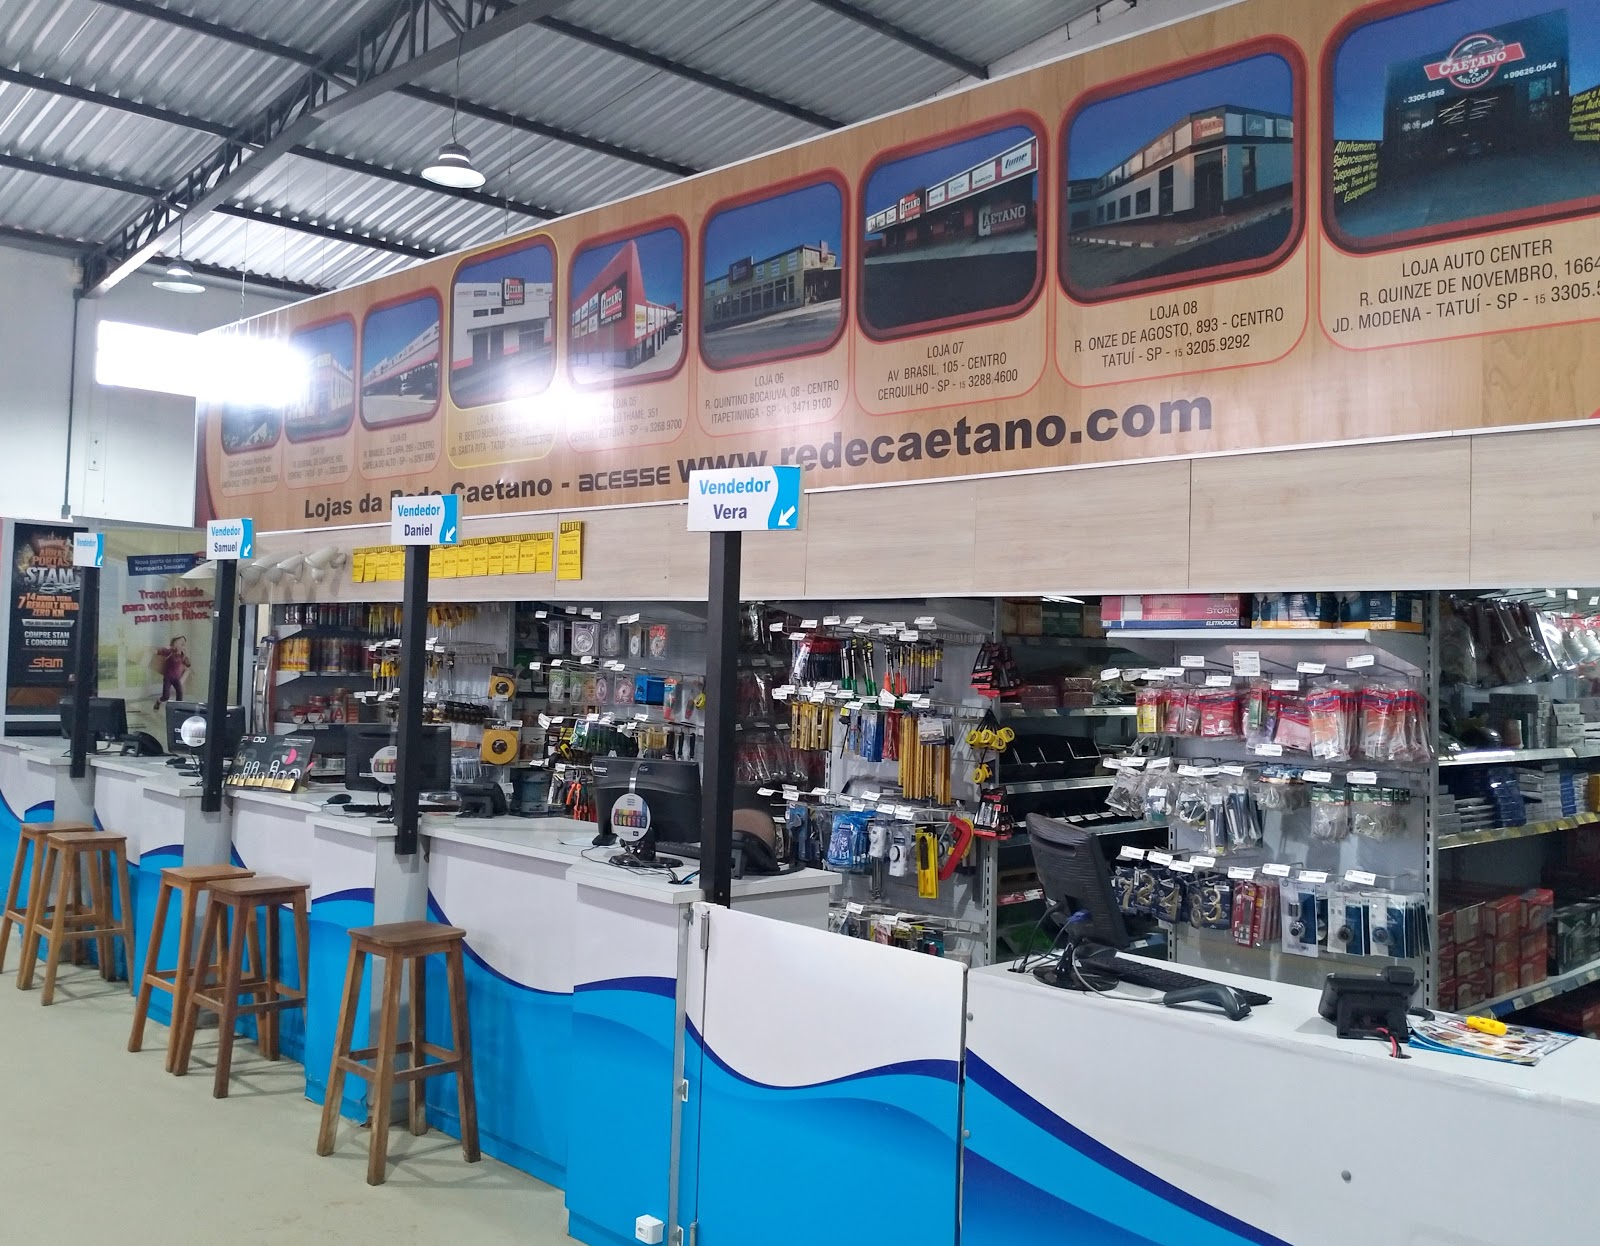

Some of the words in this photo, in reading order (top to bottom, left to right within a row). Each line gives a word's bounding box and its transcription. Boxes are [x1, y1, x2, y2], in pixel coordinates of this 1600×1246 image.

[1438, 51, 1507, 76] CAETANO
[978, 204, 1026, 237] CAETANO
[1402, 256, 1439, 278] LOJA
[1443, 249, 1485, 271] AUTO
[1490, 238, 1553, 263] CENTER
[1359, 291, 1373, 307] R.
[1378, 281, 1432, 304] QUINZE
[1437, 278, 1456, 296] DE
[1461, 262, 1558, 292] NOVEMBRO,
[1150, 303, 1180, 321] LOJA
[1183, 300, 1198, 315] 08
[1332, 317, 1353, 333] JD.
[1358, 306, 1421, 329] MODENA
[1436, 294, 1481, 319] TATUÍ
[1496, 292, 1518, 310] SP
[1534, 294, 1546, 305] 15
[1074, 340, 1085, 353] R.
[1088, 333, 1118, 352] ONZE
[1122, 331, 1137, 345] DE
[1140, 322, 1192, 343] AGOSTO,
[1196, 318, 1219, 333] 893
[1231, 306, 1284, 329] CENTRO
[927, 343, 950, 359] LOJA
[952, 341, 964, 355] 07
[1102, 347, 1135, 368] TATUÍ
[1146, 346, 1162, 362] SP
[1174, 348, 1183, 358] 15
[1186, 333, 1250, 356] 3205.9292
[942, 360, 959, 374] 105
[968, 351, 1007, 371] CENTRO
[754, 375, 773, 388] LOJA
[774, 372, 785, 384] 06
[714, 393, 748, 410] QUINTINO
[790, 386, 801, 398] 08
[807, 379, 839, 395] CENTRO
[878, 382, 929, 401] CERQUILHO
[937, 379, 950, 393] SP
[711, 408, 760, 425] ITAPETININGA
[766, 406, 777, 418] SP
[464, 429, 480, 441] BENTO
[416, 440, 435, 451] CENTRO
[699, 476, 771, 495] Vendedor
[304, 494, 353, 522] Lojas
[359, 492, 383, 513] da
[450, 478, 552, 503] Caetano
[398, 504, 441, 518] Vendedor
[713, 504, 748, 520] Vera
[211, 526, 241, 537] Vendedor
[404, 523, 433, 538] Daniel
[214, 542, 238, 553] Samuel
[32, 556, 70, 567] PORTAS
[24, 566, 74, 585] STAM
[138, 586, 204, 600] Tranquilidade
[26, 600, 59, 610] RENAULT
[32, 608, 51, 616] ZERO
[122, 603, 146, 614] para
[1206, 606, 1238, 615] STORM
[134, 614, 158, 626] para
[159, 612, 180, 622] seus
[182, 609, 211, 620] filhos.
[24, 630, 52, 639] COMPRE
[30, 639, 68, 647] CONCORRA!
